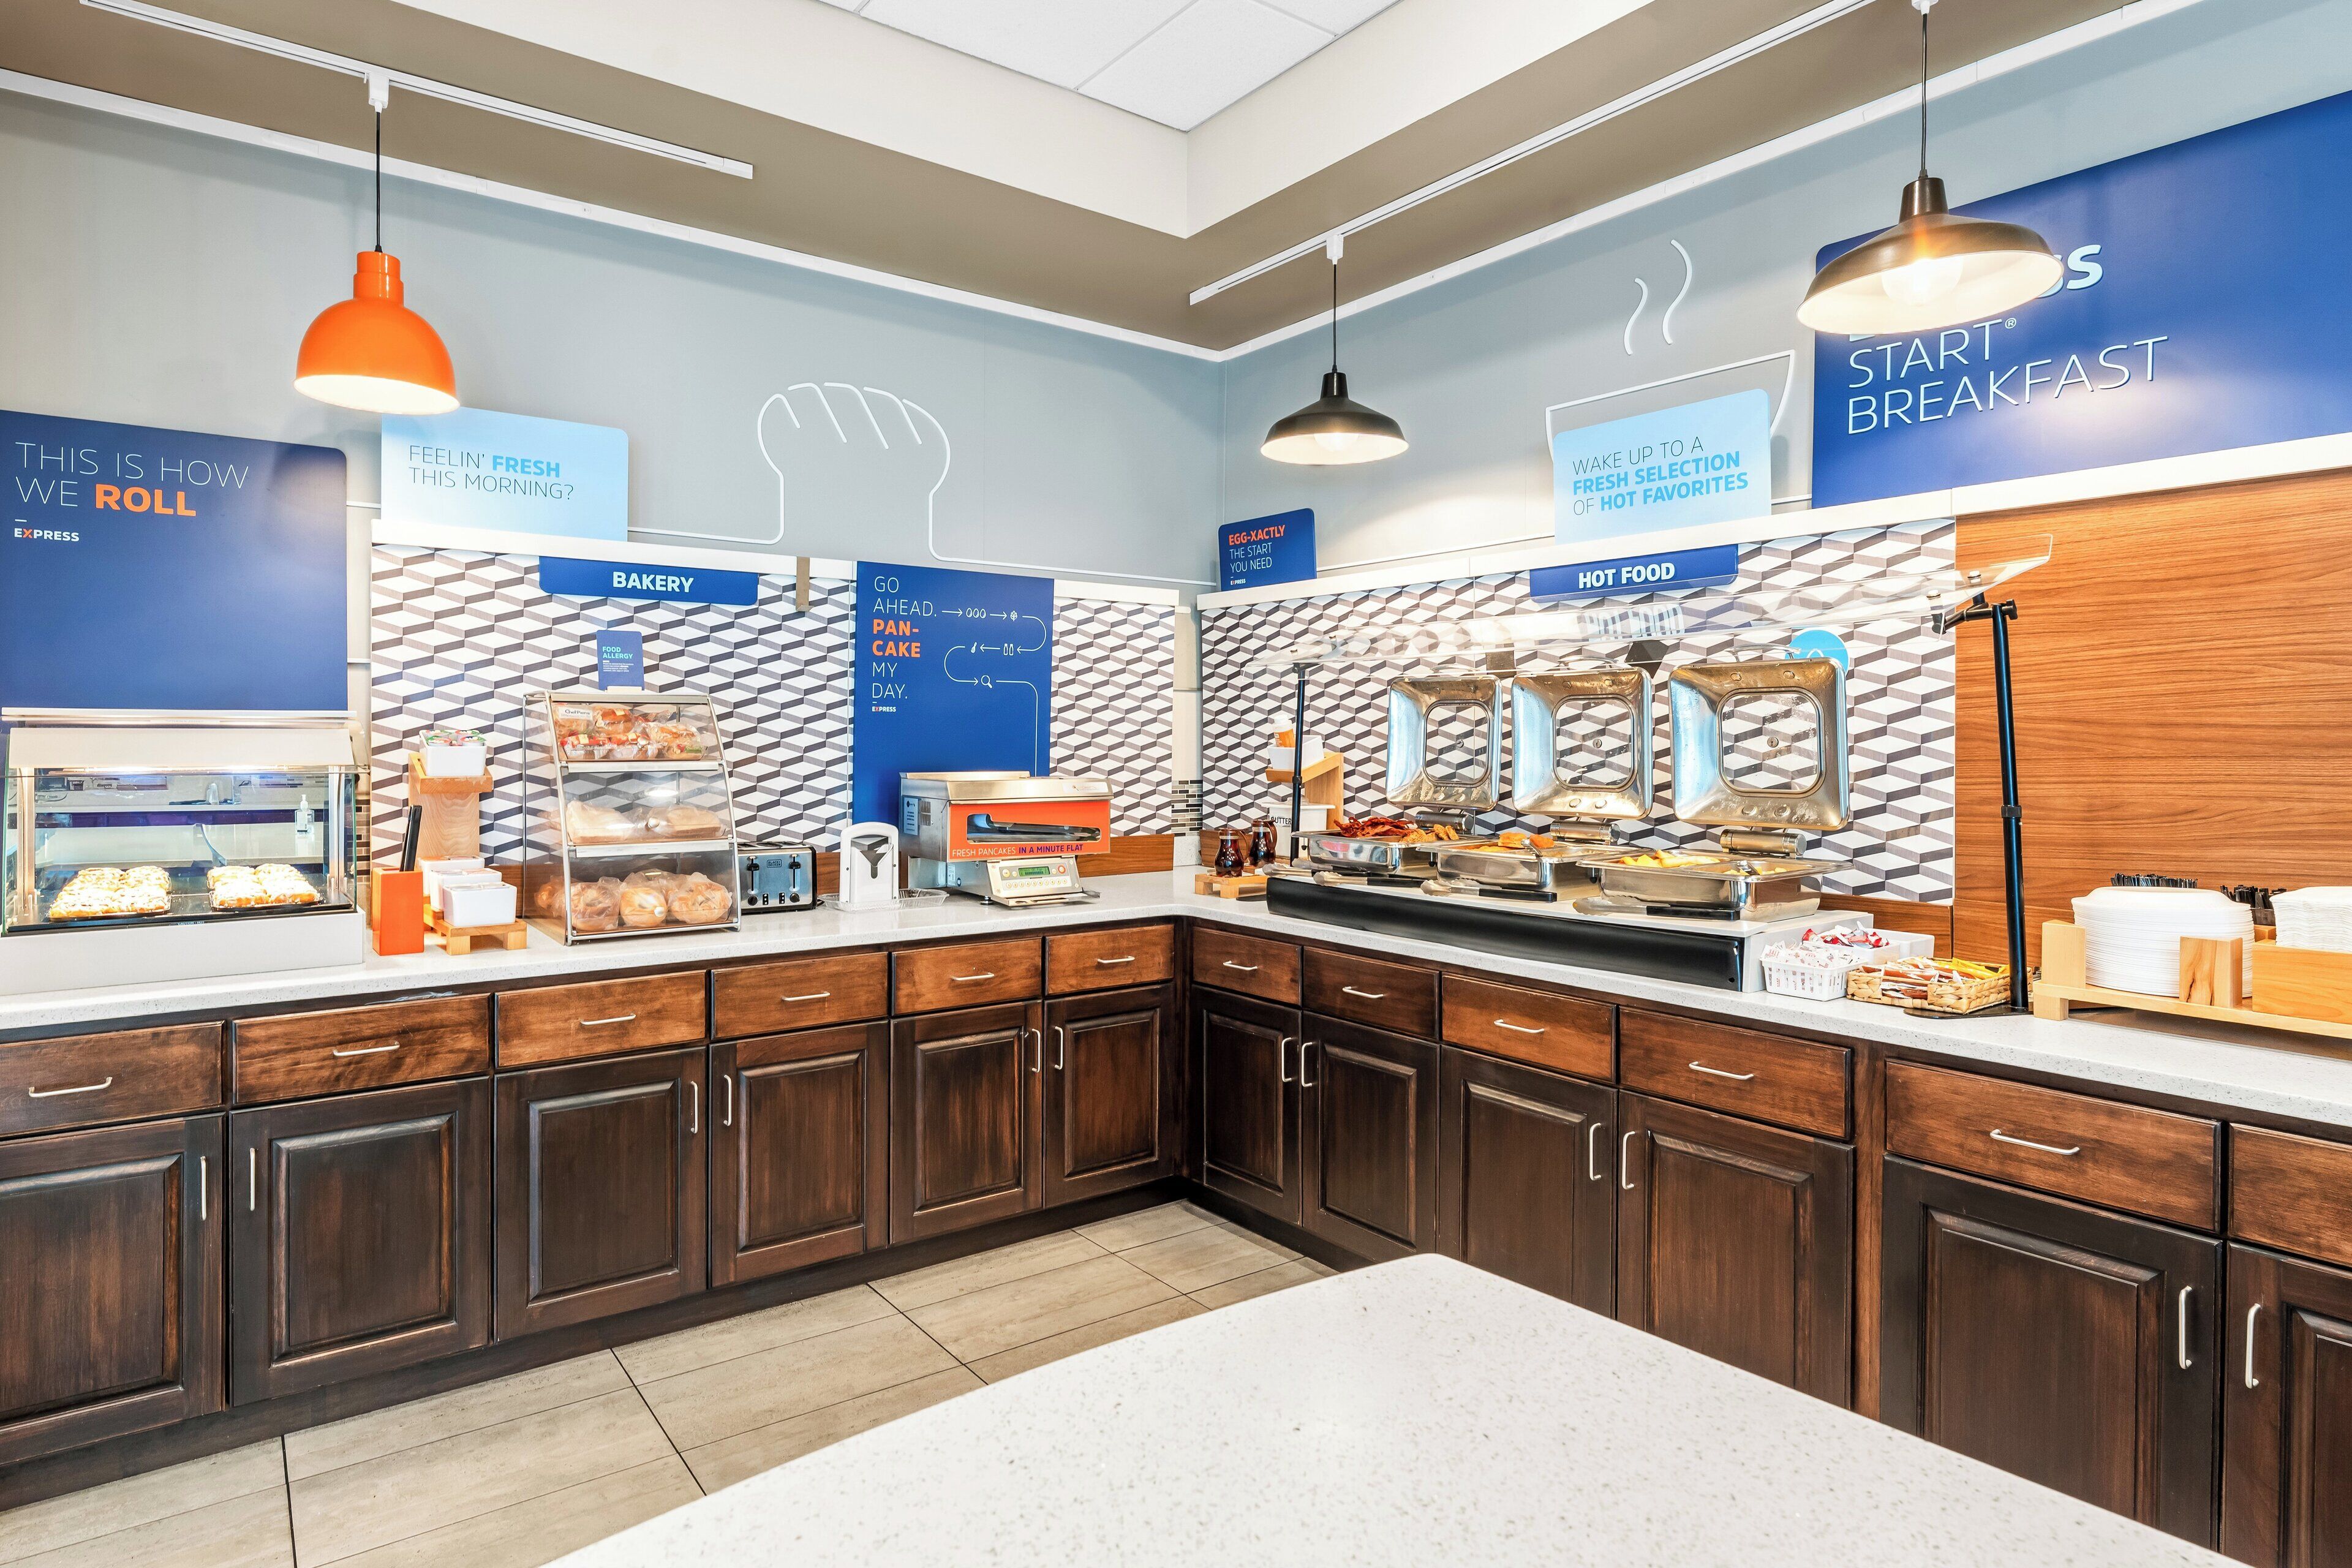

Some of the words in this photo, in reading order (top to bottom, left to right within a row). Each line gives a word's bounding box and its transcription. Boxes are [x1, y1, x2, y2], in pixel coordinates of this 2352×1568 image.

[1849, 336, 2169, 435] BREAKFAST
[15, 442, 99, 475] THIS
[116, 453, 143, 480] IS
[160, 457, 249, 489] HOW
[492, 454, 560, 478] FRESH
[1573, 451, 1622, 476] WAKE
[1629, 446, 1653, 466] UP
[1660, 440, 1683, 459] TO
[1691, 436, 1703, 453] A
[409, 467, 456, 488] THIS
[465, 474, 574, 500] MORNING?
[1573, 472, 1629, 495] FRESH
[1635, 451, 1740, 485] SELECTION
[15, 477, 78, 507] WE
[95, 483, 197, 516] ROLL
[1573, 499, 1594, 516] OF
[1600, 491, 1637, 511] HOT
[1643, 472, 1748, 505] FAVORITES
[14, 527, 80, 542] EXPRESS
[1229, 525, 1286, 546] EGG-XACTLY
[1230, 547, 1245, 560] THE
[1247, 542, 1272, 557] START
[1231, 560, 1248, 573] YOU
[1250, 557, 1272, 570] NEED
[1578, 569, 1616, 589] HOT
[1621, 562, 1675, 584] FOOD
[612, 571, 694, 593] BAKERY
[874, 576, 899, 594] GO
[873, 597, 937, 617] AHEAD.
[872, 619, 919, 636] PAN-
[872, 640, 921, 658] CAKE
[872, 662, 898, 678] MY
[872, 682, 908, 699] DAY.
[952, 848, 976, 857] FRESH
[978, 846, 1016, 856] PANCAKES
[1019, 845, 1027, 854] IN
[1036, 845, 1064, 853] MINUTE
[1066, 843, 1084, 852] FLAT
